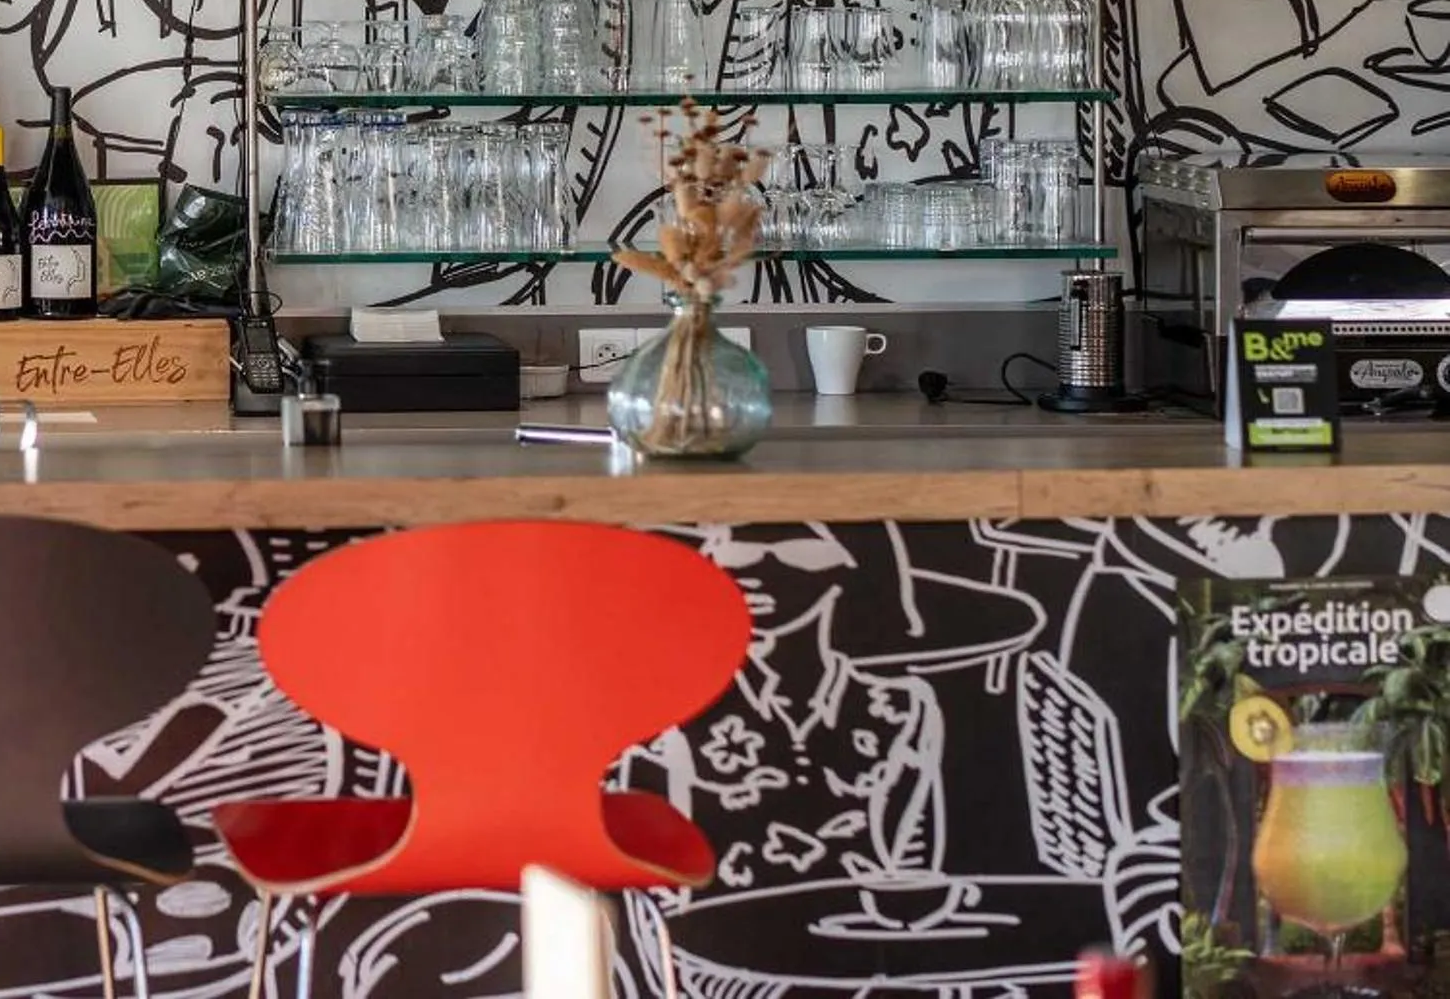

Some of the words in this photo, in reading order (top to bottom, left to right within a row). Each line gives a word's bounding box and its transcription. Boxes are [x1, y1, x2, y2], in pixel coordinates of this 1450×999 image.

[16, 335, 189, 394] Entre-Elles
[1231, 601, 1414, 643] Expédition
[1246, 633, 1400, 674] tropicale
